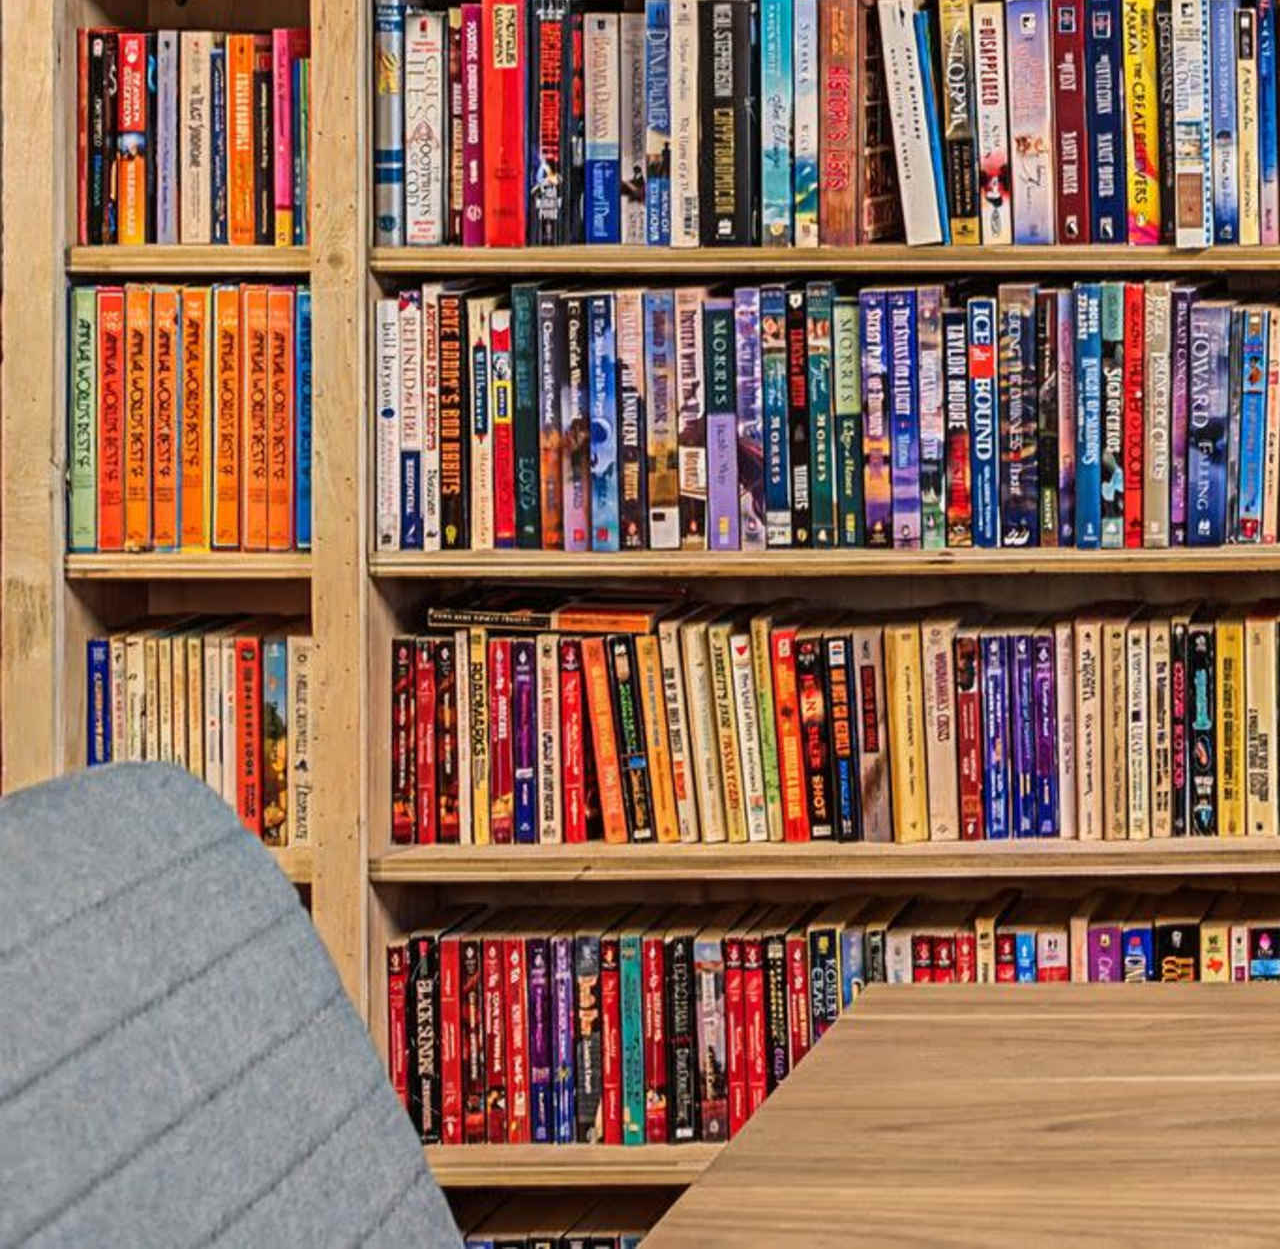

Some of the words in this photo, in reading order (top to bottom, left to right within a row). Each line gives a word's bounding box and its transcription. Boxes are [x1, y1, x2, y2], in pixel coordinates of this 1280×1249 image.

[646, 29, 666, 73] DIANA
[979, 28, 999, 106] DISAPPEARED
[647, 76, 666, 131] PALMER
[713, 109, 734, 213] CRYPTONOMICON
[382, 321, 398, 353] bill
[946, 323, 965, 374] TAYLOR
[971, 305, 990, 346] ICE
[382, 357, 398, 406] bryson
[712, 317, 729, 405] MORRIS
[839, 318, 857, 406] MORRIS
[1190, 323, 1210, 428] HOWARD
[947, 380, 966, 429] MOORE
[972, 377, 992, 460] BOUND
[443, 445, 462, 495] HABITS
[1195, 441, 1212, 510] FALLING
[470, 661, 485, 756] ROADMARKS
